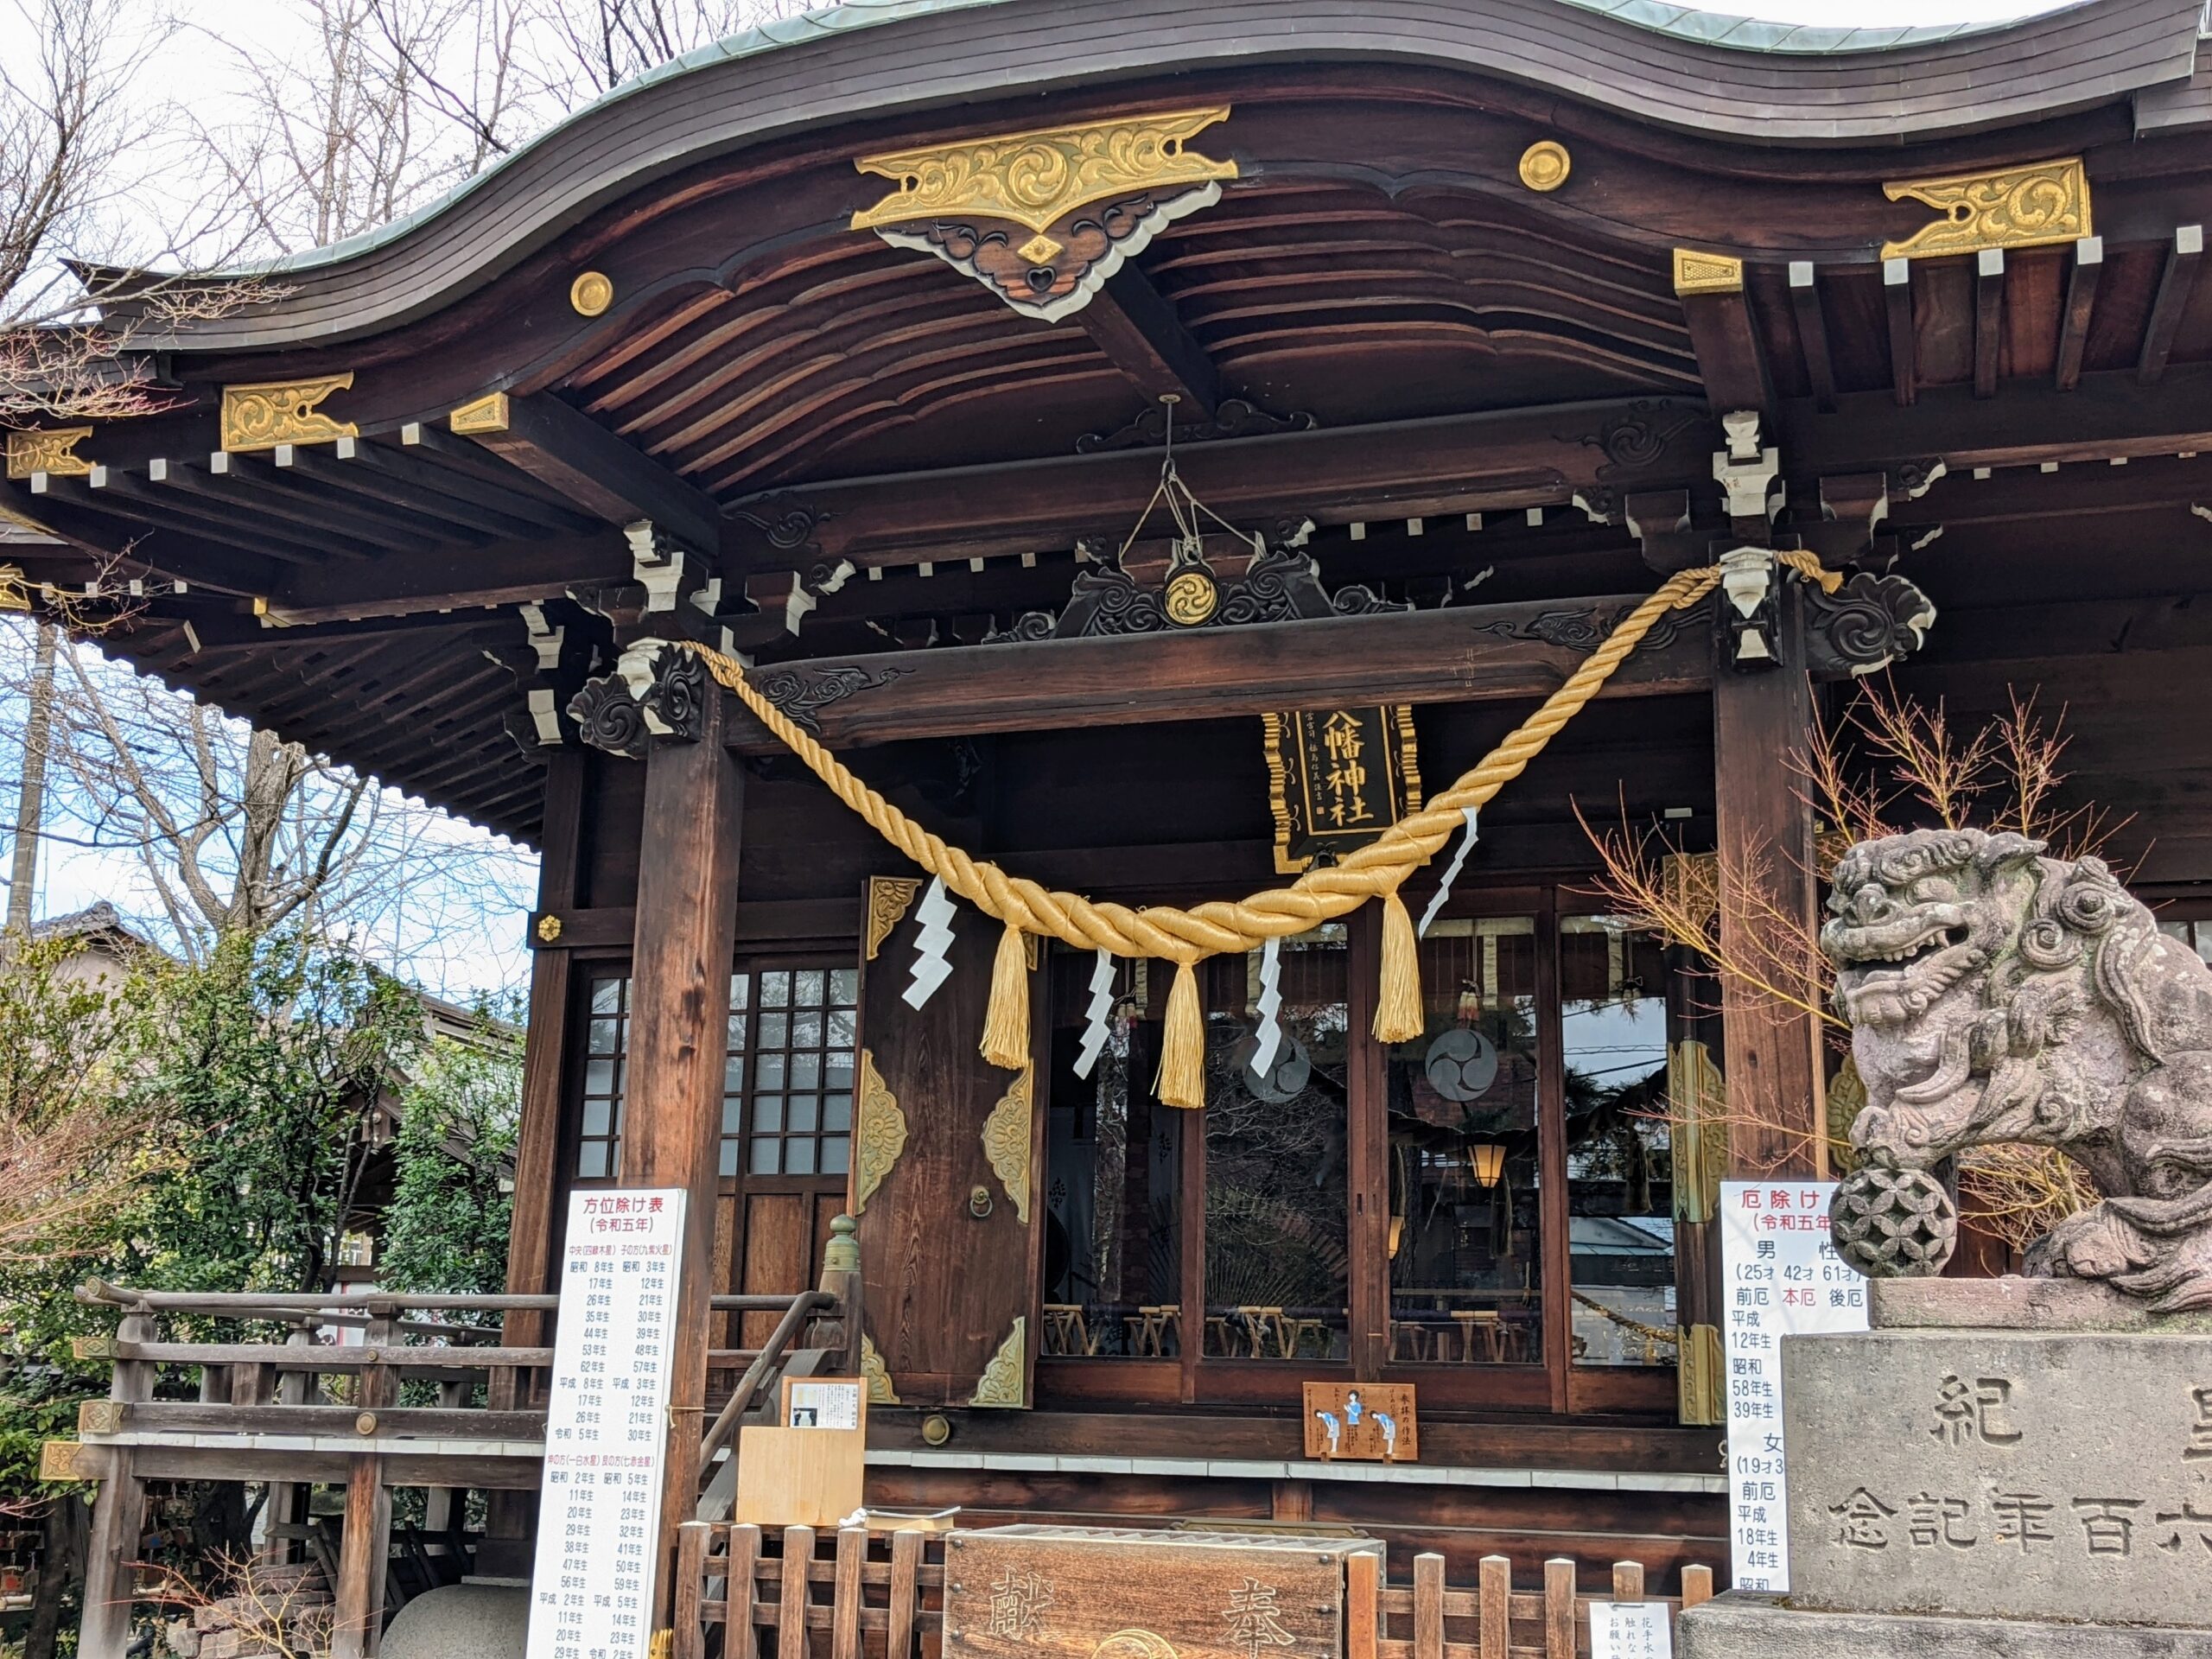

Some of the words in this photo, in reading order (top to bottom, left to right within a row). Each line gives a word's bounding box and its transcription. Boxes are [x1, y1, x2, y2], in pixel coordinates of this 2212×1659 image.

[1322, 710, 1374, 828] 八幡神社
[583, 1197, 663, 1214] 方位除け表
[1742, 1190, 1835, 1209] 厄除け
[590, 1217, 653, 1234] (令和五年)
[1757, 1241, 1775, 1259] 男
[570, 1262, 588, 1273] 昭和
[594, 1262, 613, 1273] 8年生
[623, 1262, 639, 1272] 昭和
[646, 1262, 665, 1272] 3年生
[589, 1278, 612, 1289] 17年生
[641, 1278, 664, 1289] 12年生
[587, 1294, 611, 1306] 26年生
[639, 1294, 662, 1306] 21年生
[1737, 1287, 1769, 1306] 前厄
[1782, 1287, 1815, 1306] 本厄
[1829, 1288, 1863, 1306] 後厄
[586, 1311, 609, 1322] 35年生
[638, 1311, 661, 1322] 30年生
[1732, 1311, 1760, 1327] 平成
[584, 1328, 607, 1338] 44年生
[637, 1327, 659, 1339] 39年生
[1732, 1332, 1771, 1349] 12年生
[582, 1344, 607, 1356] 53年生
[635, 1344, 658, 1356] 48年生
[581, 1361, 604, 1372] 62年生
[633, 1361, 657, 1373] 57年生
[1733, 1358, 1762, 1375] 昭和
[560, 1377, 575, 1389] 平成
[583, 1377, 603, 1389] 8年生
[613, 1378, 629, 1389] 平成
[637, 1378, 656, 1389] 3年生
[1732, 1380, 1773, 1396] 58年生
[579, 1395, 601, 1406] 17年生
[632, 1395, 654, 1407] 12年生
[1734, 1402, 1773, 1418] 39年生
[576, 1412, 600, 1423] 26年生
[629, 1413, 652, 1424] 21年生
[556, 1428, 571, 1439] 令和
[579, 1428, 598, 1440] 5年生
[628, 1429, 651, 1440] 30年生
[550, 1471, 568, 1483] 昭和
[575, 1472, 594, 1484] 2年生
[604, 1472, 621, 1484] 昭和
[628, 1473, 647, 1485] 5年生
[570, 1490, 594, 1501] 11年生
[623, 1491, 646, 1503] 14年生
[1742, 1481, 1776, 1501] 前厄
[568, 1507, 592, 1518] 20年生
[620, 1508, 645, 1520] 23年生
[1738, 1506, 1766, 1523] 平成
[566, 1524, 590, 1535] 29年生
[620, 1525, 643, 1537] 32年生
[1738, 1528, 1777, 1546] 18年生
[564, 1541, 588, 1553] 38年生
[618, 1543, 642, 1555] 41年生
[563, 1559, 587, 1571] 47年生
[616, 1560, 640, 1573] 50年生
[1748, 1551, 1778, 1568] 4年生
[562, 1576, 586, 1588] 56年生
[615, 1578, 639, 1591] 59年生
[1740, 1578, 1769, 1591] 昭和
[540, 1592, 556, 1605] 平成
[564, 1593, 584, 1605] 2年生
[594, 1595, 610, 1607] 平成
[618, 1596, 638, 1608] 5年生
[559, 1611, 582, 1624] 11年生
[613, 1614, 636, 1626] 14年生
[556, 1629, 581, 1642] 20年生
[610, 1631, 634, 1644] 23年生
[1625, 1618, 1637, 1659] 触れな
[1642, 1618, 1654, 1659] 花手水
[555, 1647, 579, 1659] 29年生
[589, 1649, 606, 1659] 令和
[613, 1649, 632, 1659] 2年生
